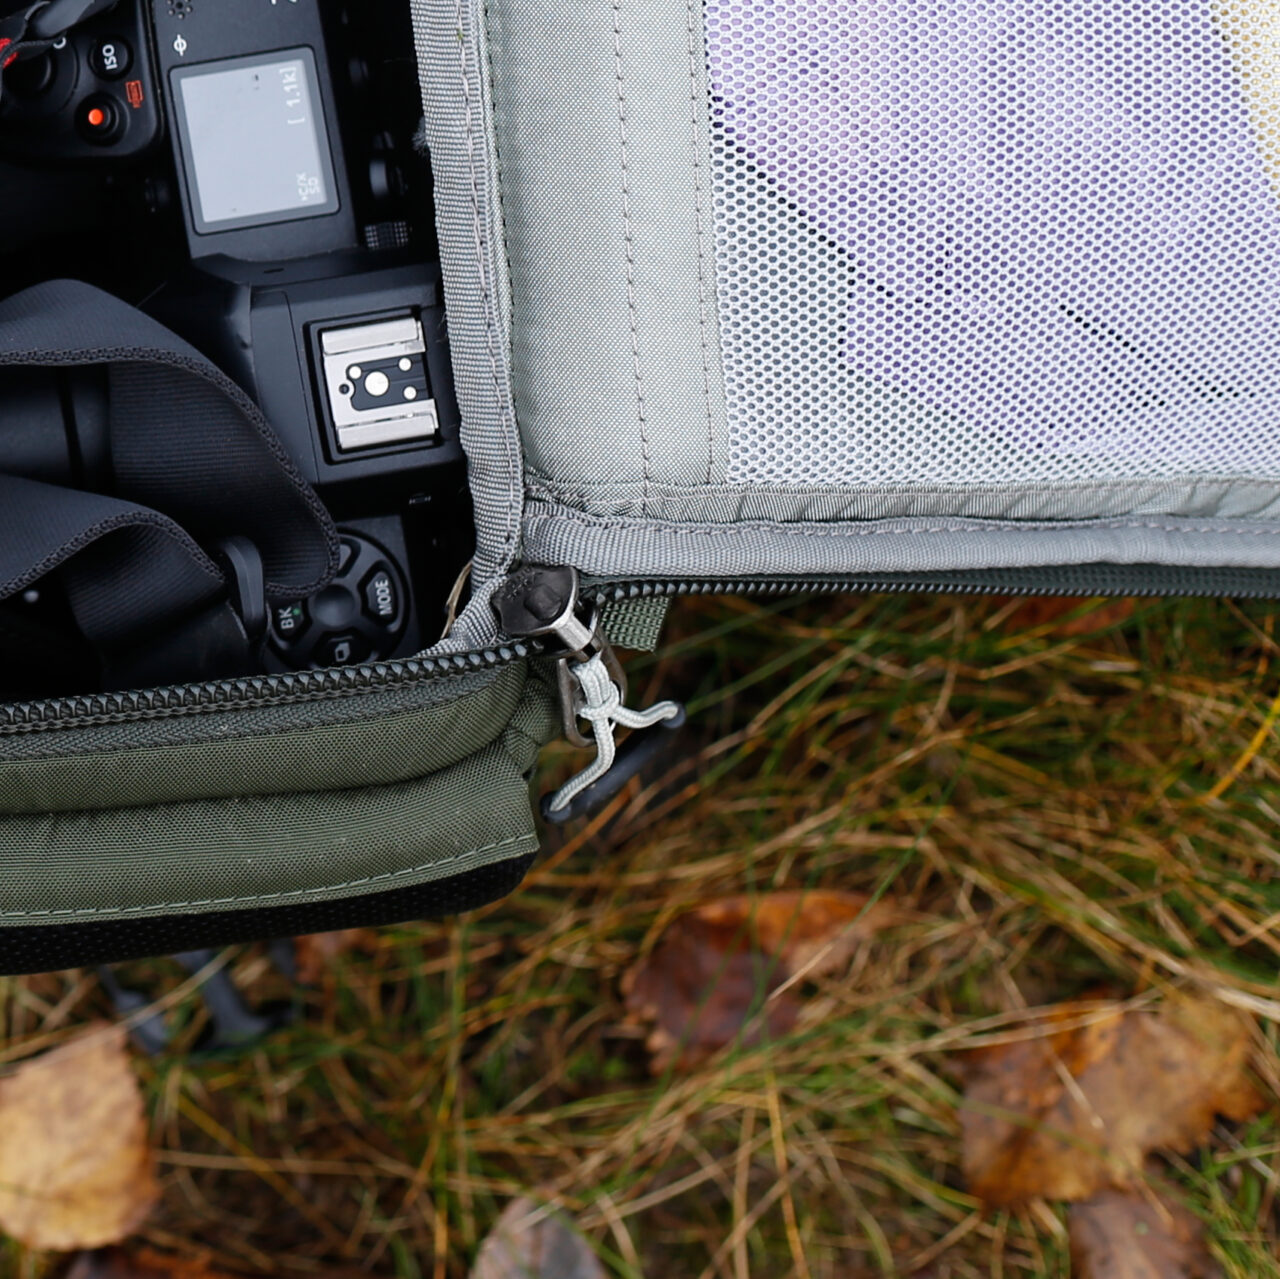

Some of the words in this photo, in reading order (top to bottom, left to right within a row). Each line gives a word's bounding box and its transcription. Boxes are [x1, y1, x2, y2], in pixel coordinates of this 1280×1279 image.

[102, 44, 118, 70] ISO
[374, 579, 393, 616] MODE
[278, 606, 295, 630] BK
